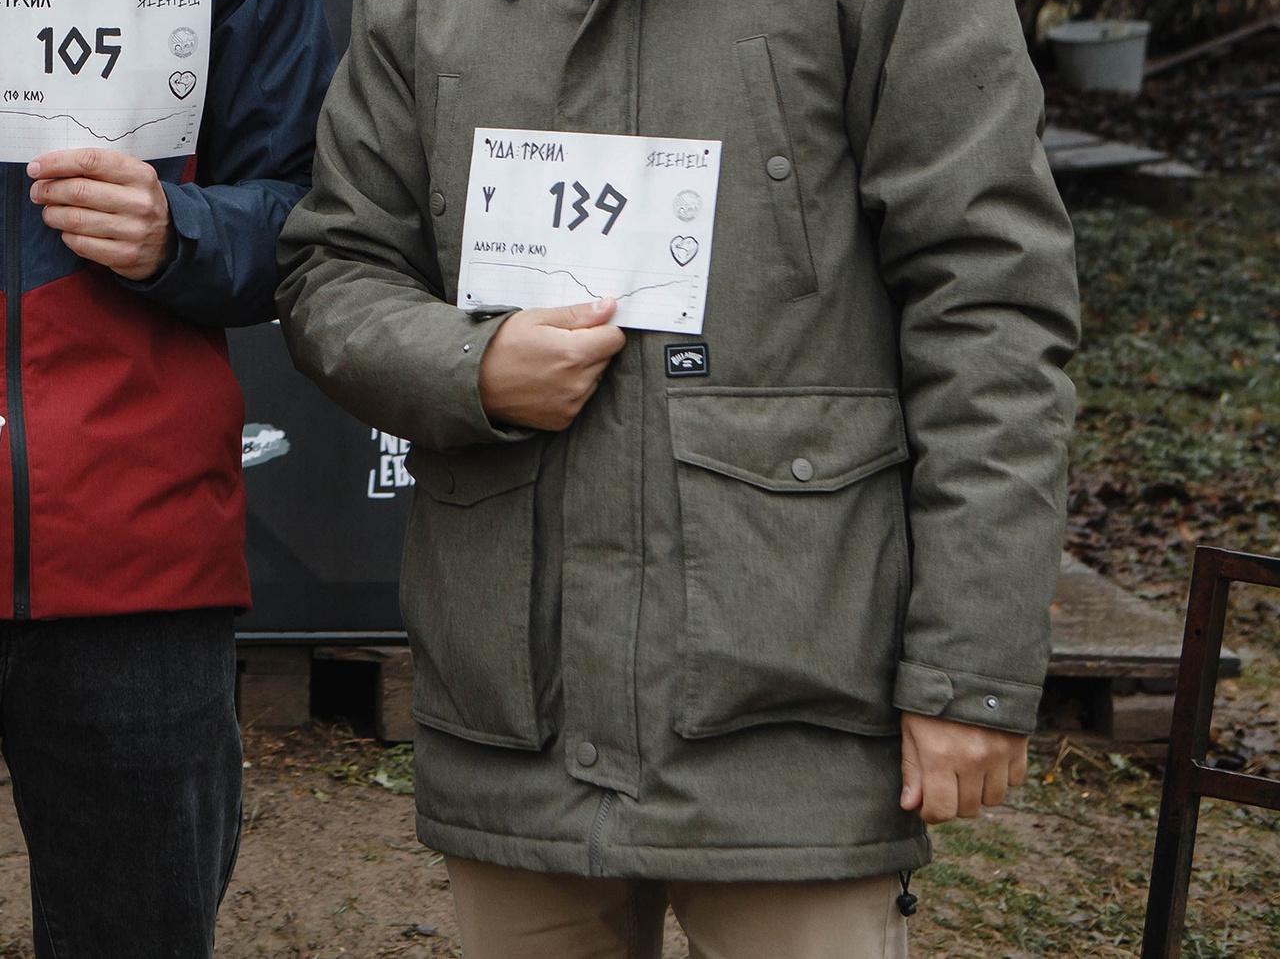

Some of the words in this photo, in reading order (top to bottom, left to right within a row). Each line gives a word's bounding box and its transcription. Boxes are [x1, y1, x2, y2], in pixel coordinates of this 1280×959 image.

[36, 26, 122, 80] 105
[549, 180, 628, 236] 139
[473, 240, 507, 253] АЛЬГИЗ
